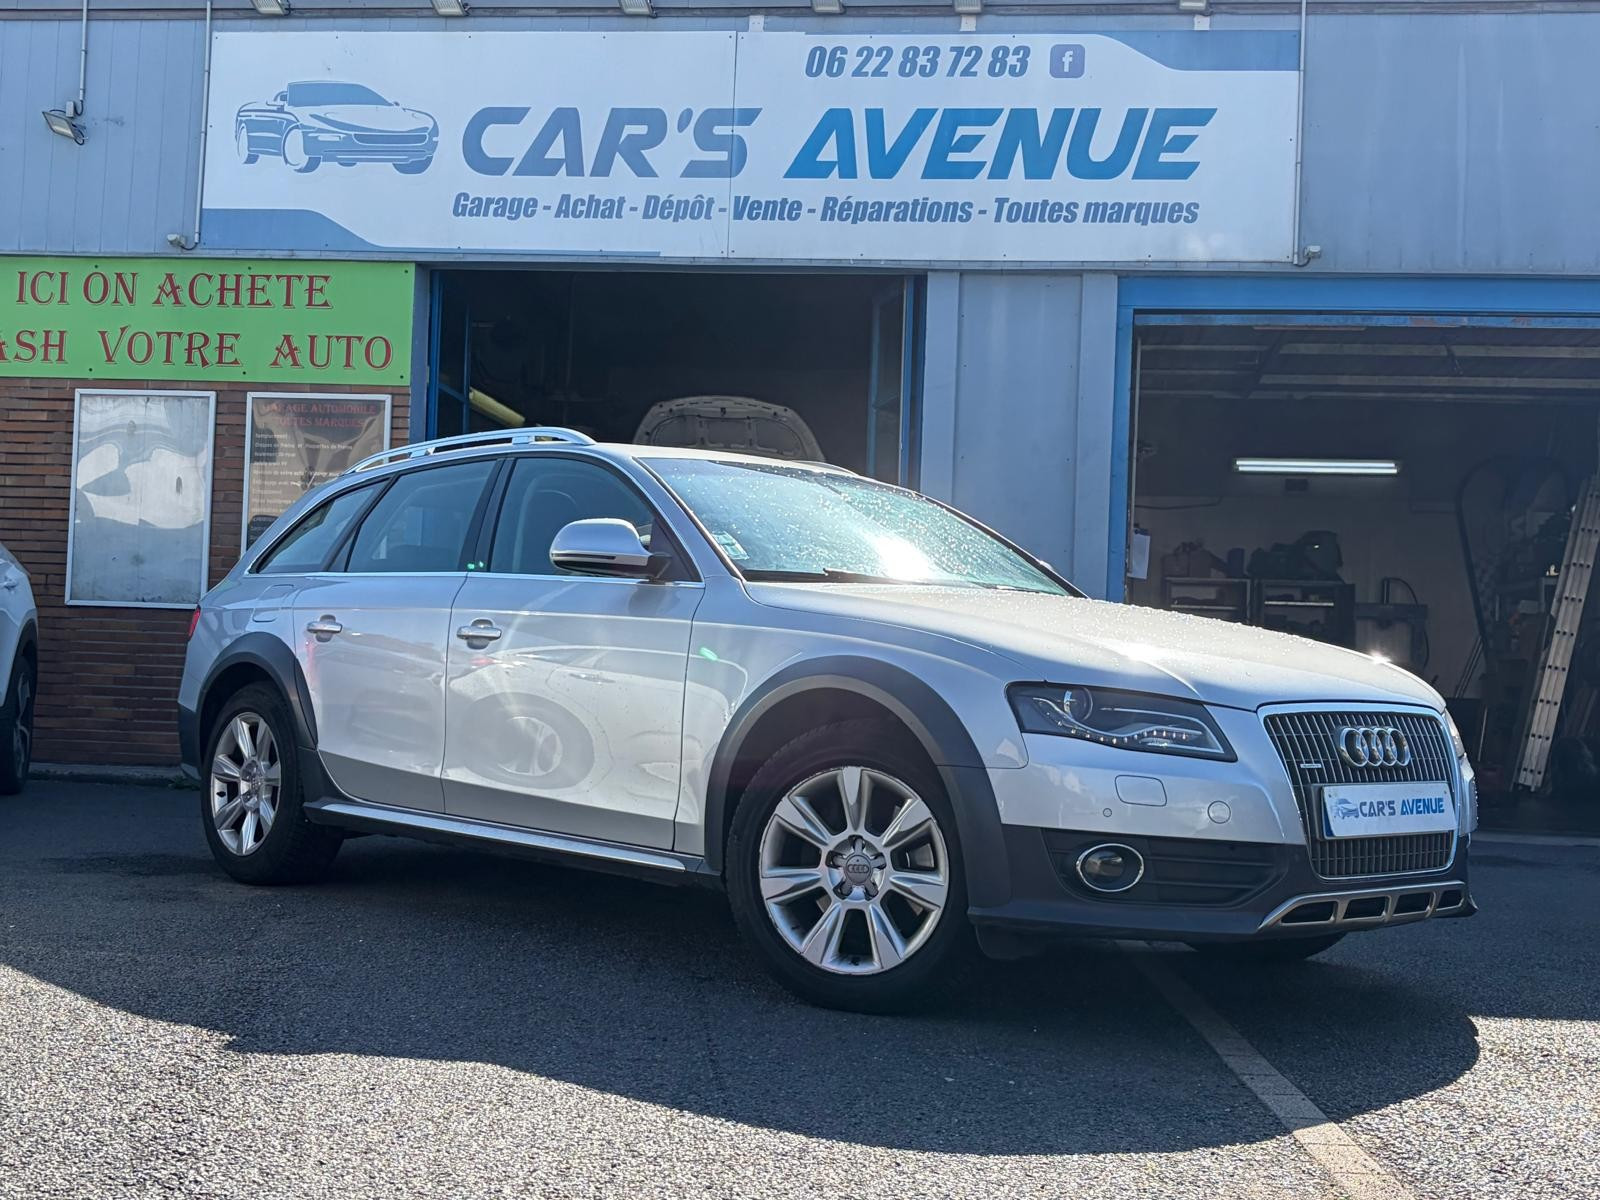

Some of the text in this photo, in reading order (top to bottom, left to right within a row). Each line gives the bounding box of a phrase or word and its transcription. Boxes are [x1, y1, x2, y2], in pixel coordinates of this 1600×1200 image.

[805, 45, 1032, 79] 06 22 83 72 83
[461, 106, 1219, 182] CAR'S AVENUE
[453, 191, 539, 222] Garage
[554, 193, 627, 220] Achat
[642, 192, 716, 224] Dépôt
[732, 195, 804, 223] Vente
[820, 194, 975, 225] Réparations
[993, 196, 1080, 224] Toutes
[1082, 201, 1201, 227] marques
[16, 271, 333, 308] ICI ON ACHETE
[97, 325, 242, 368] VOTRE
[270, 334, 393, 370] AUTO
[1360, 797, 1445, 817] CAR'S AVENUE
